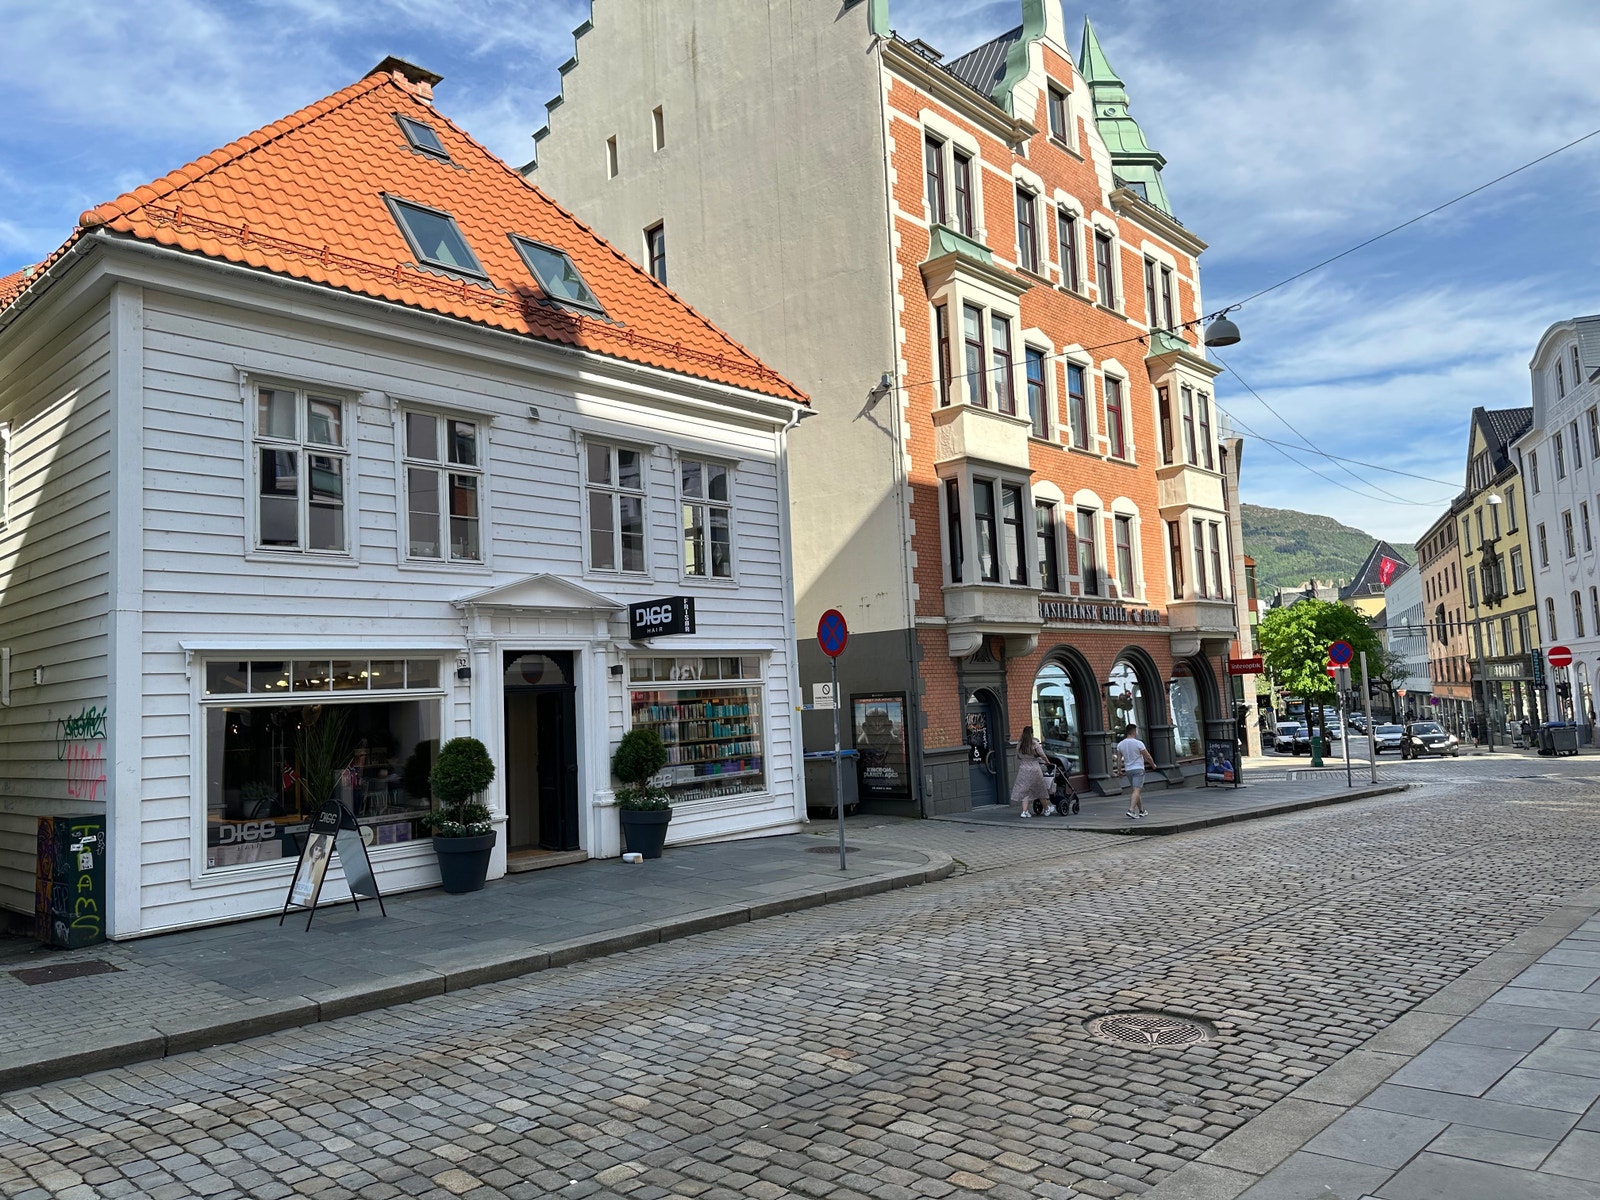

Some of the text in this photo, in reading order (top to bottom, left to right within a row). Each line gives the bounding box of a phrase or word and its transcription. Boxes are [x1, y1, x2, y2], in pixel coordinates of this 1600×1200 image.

[635, 604, 672, 627] DIGG
[1144, 610, 1161, 623] BAR
[646, 773, 673, 788] IGG
[319, 812, 337, 824] DIGG
[220, 820, 276, 844] DIGG
